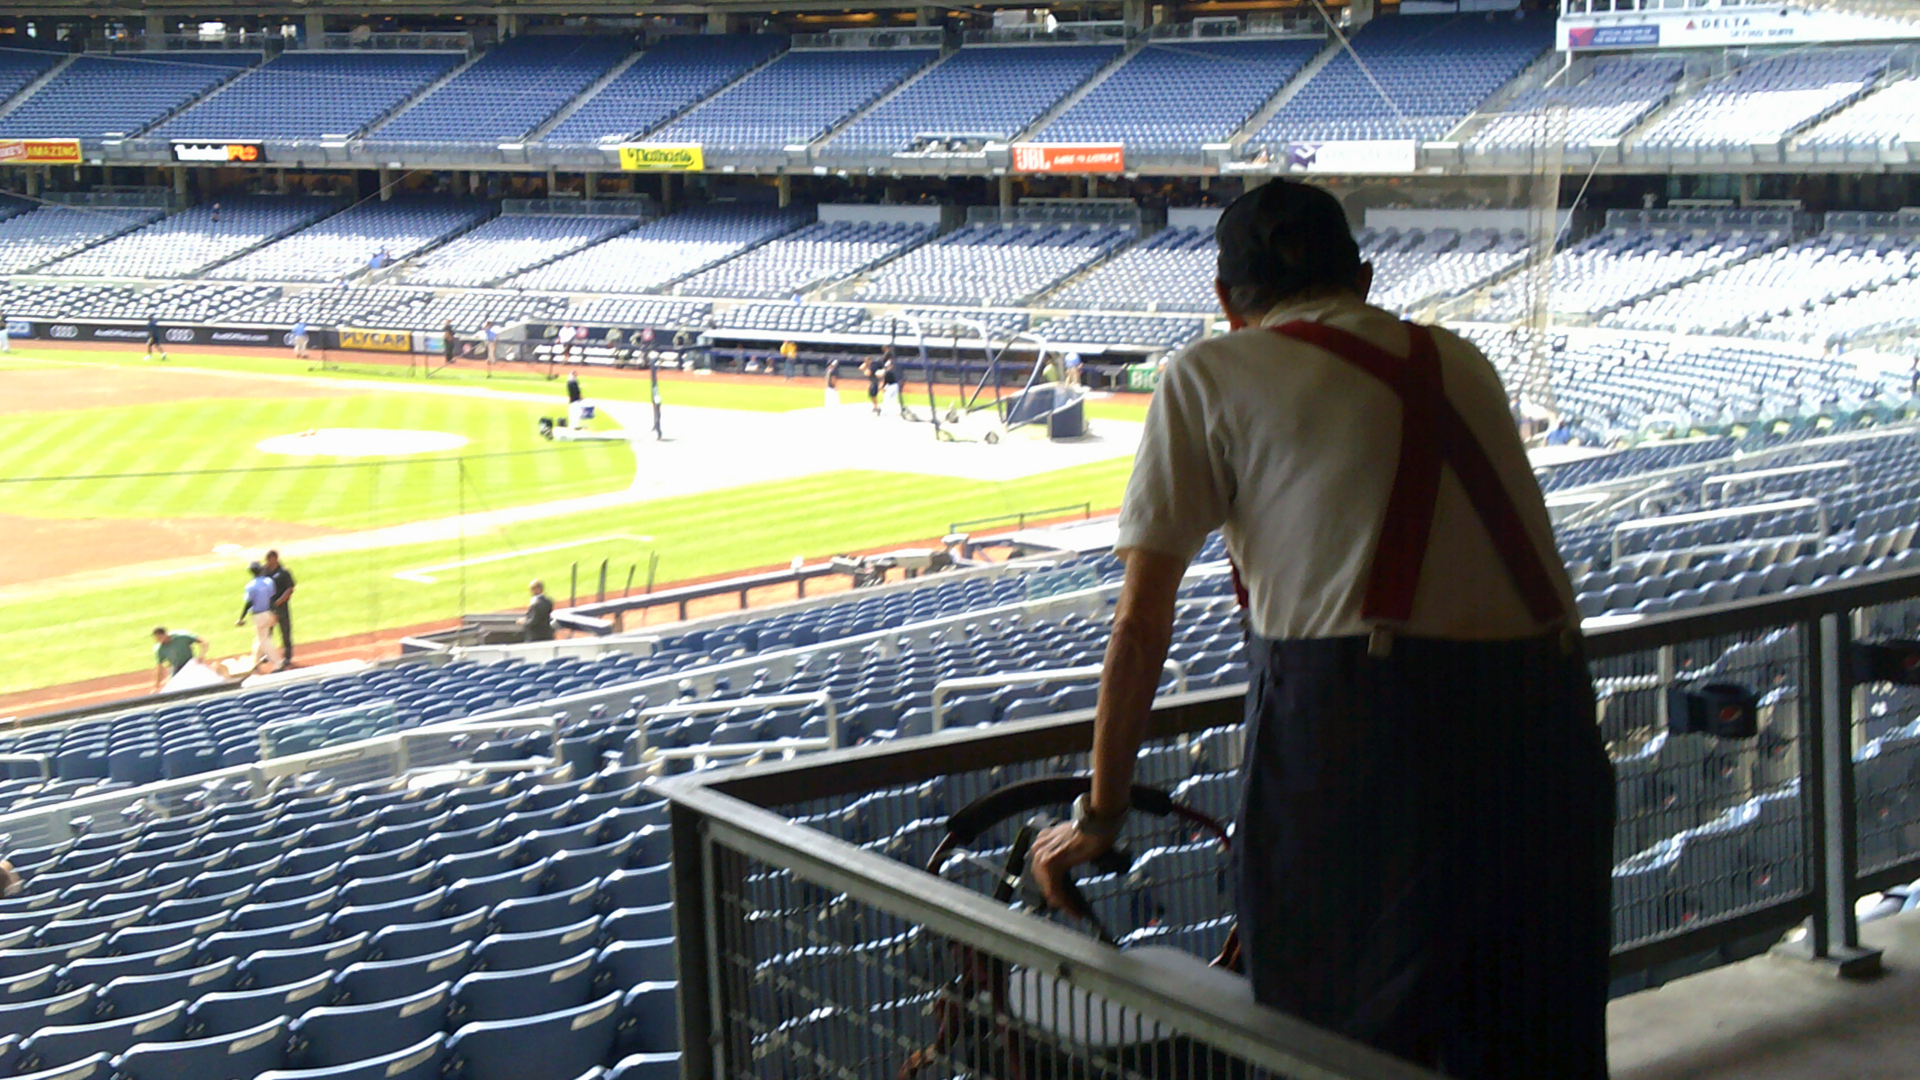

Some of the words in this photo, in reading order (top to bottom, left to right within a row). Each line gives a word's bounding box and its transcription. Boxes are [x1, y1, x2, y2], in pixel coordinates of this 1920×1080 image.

[1701, 18, 1751, 29] DELTA
[27, 145, 77, 157] AMAZING
[628, 147, 693, 163] Nathan's
[1016, 148, 1051, 170] JBL
